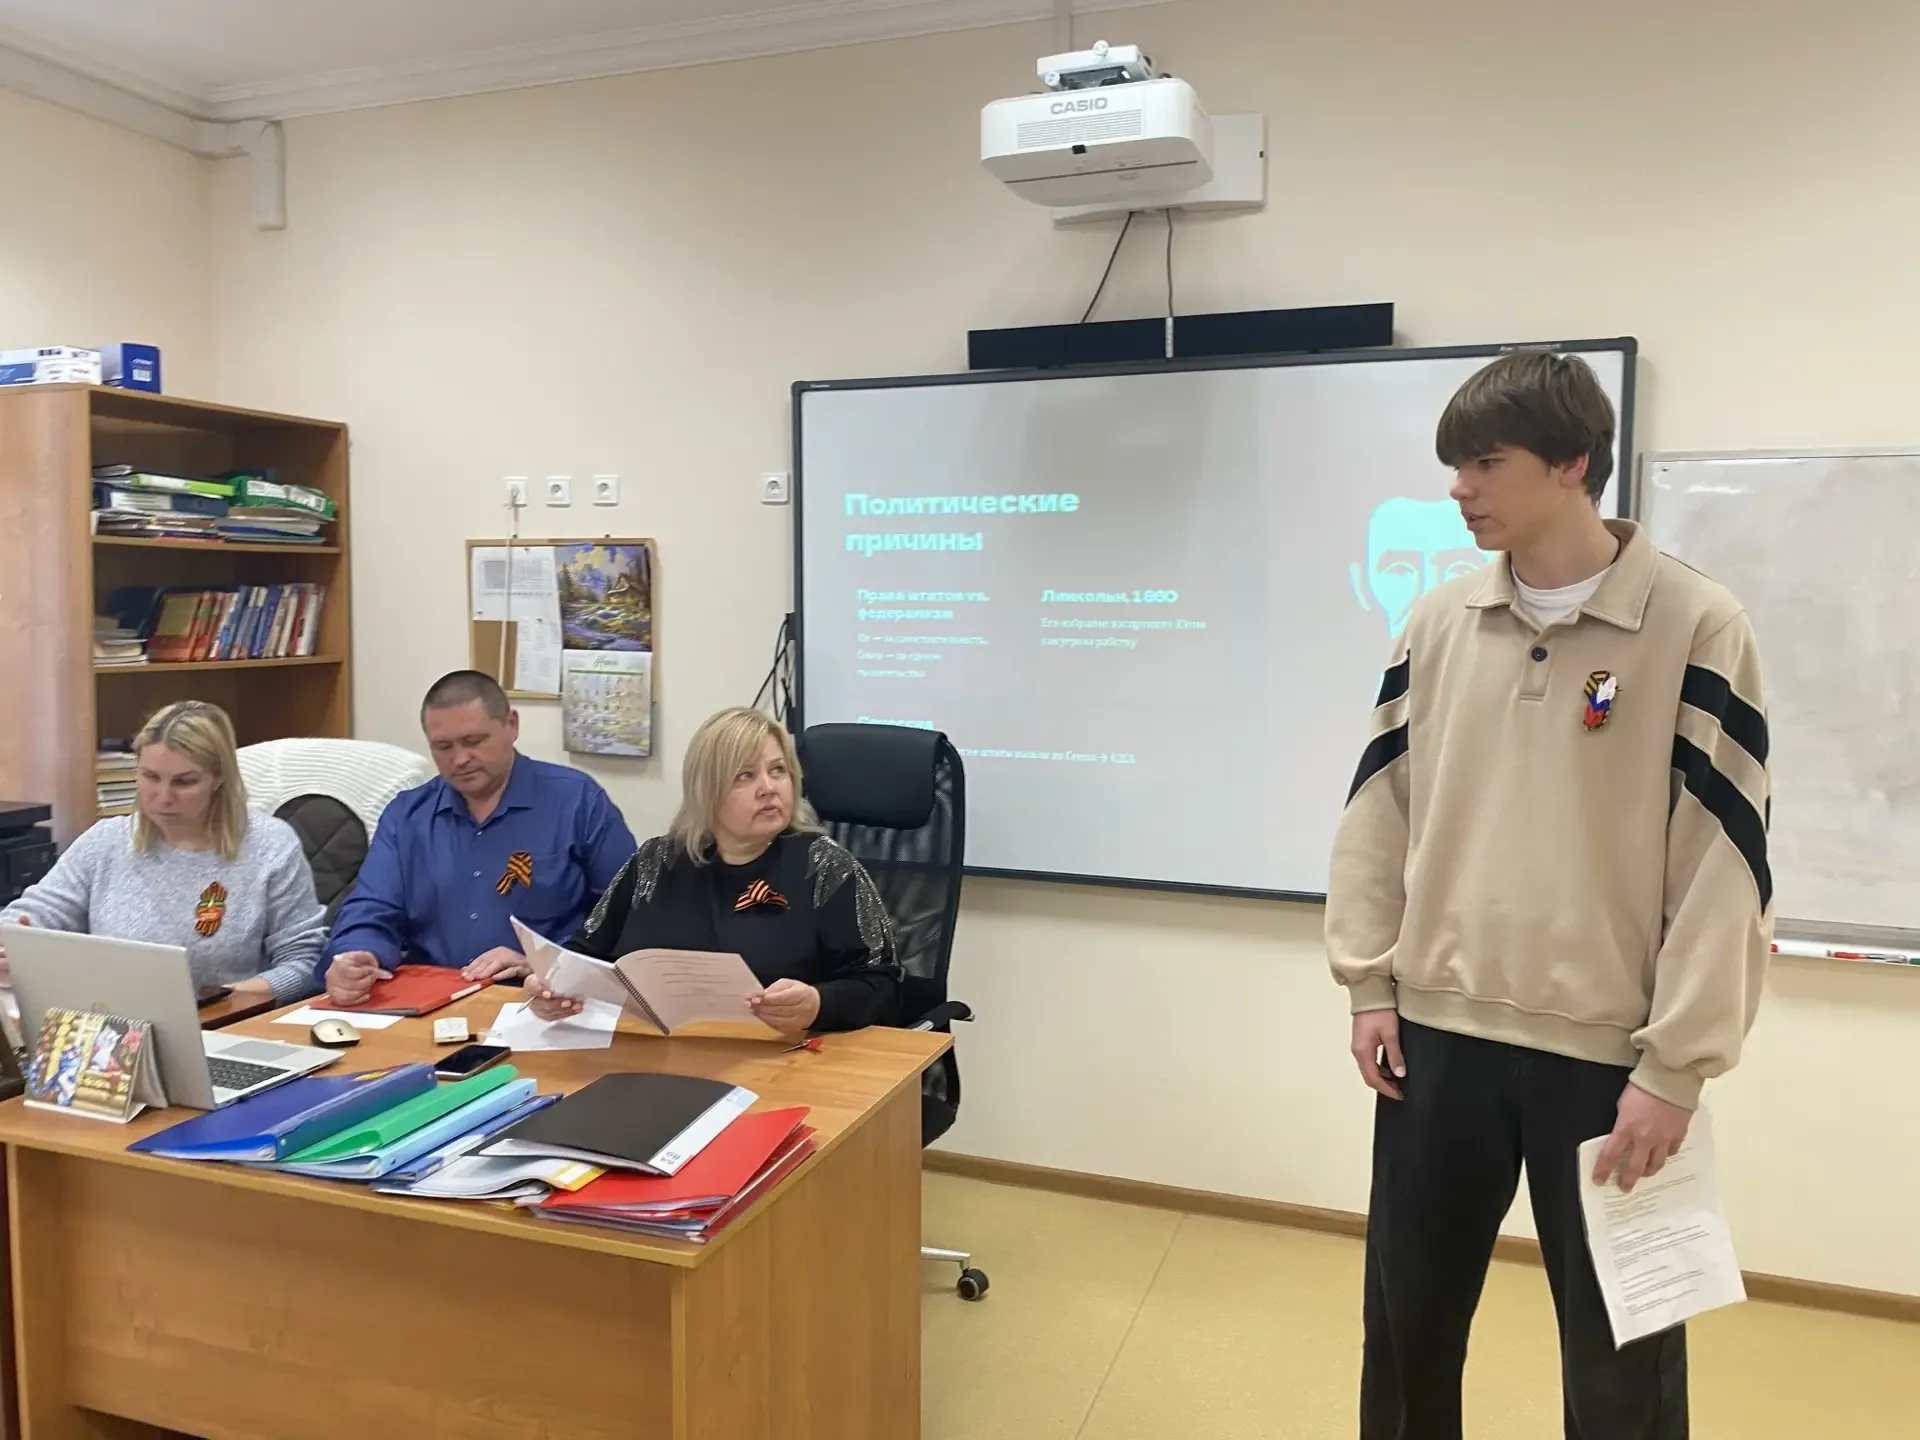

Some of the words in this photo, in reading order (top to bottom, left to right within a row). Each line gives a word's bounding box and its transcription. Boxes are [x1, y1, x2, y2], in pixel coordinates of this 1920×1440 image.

[1050, 97, 1108, 115] CASIO
[845, 493, 1081, 516] Политические
[845, 532, 984, 557] причины
